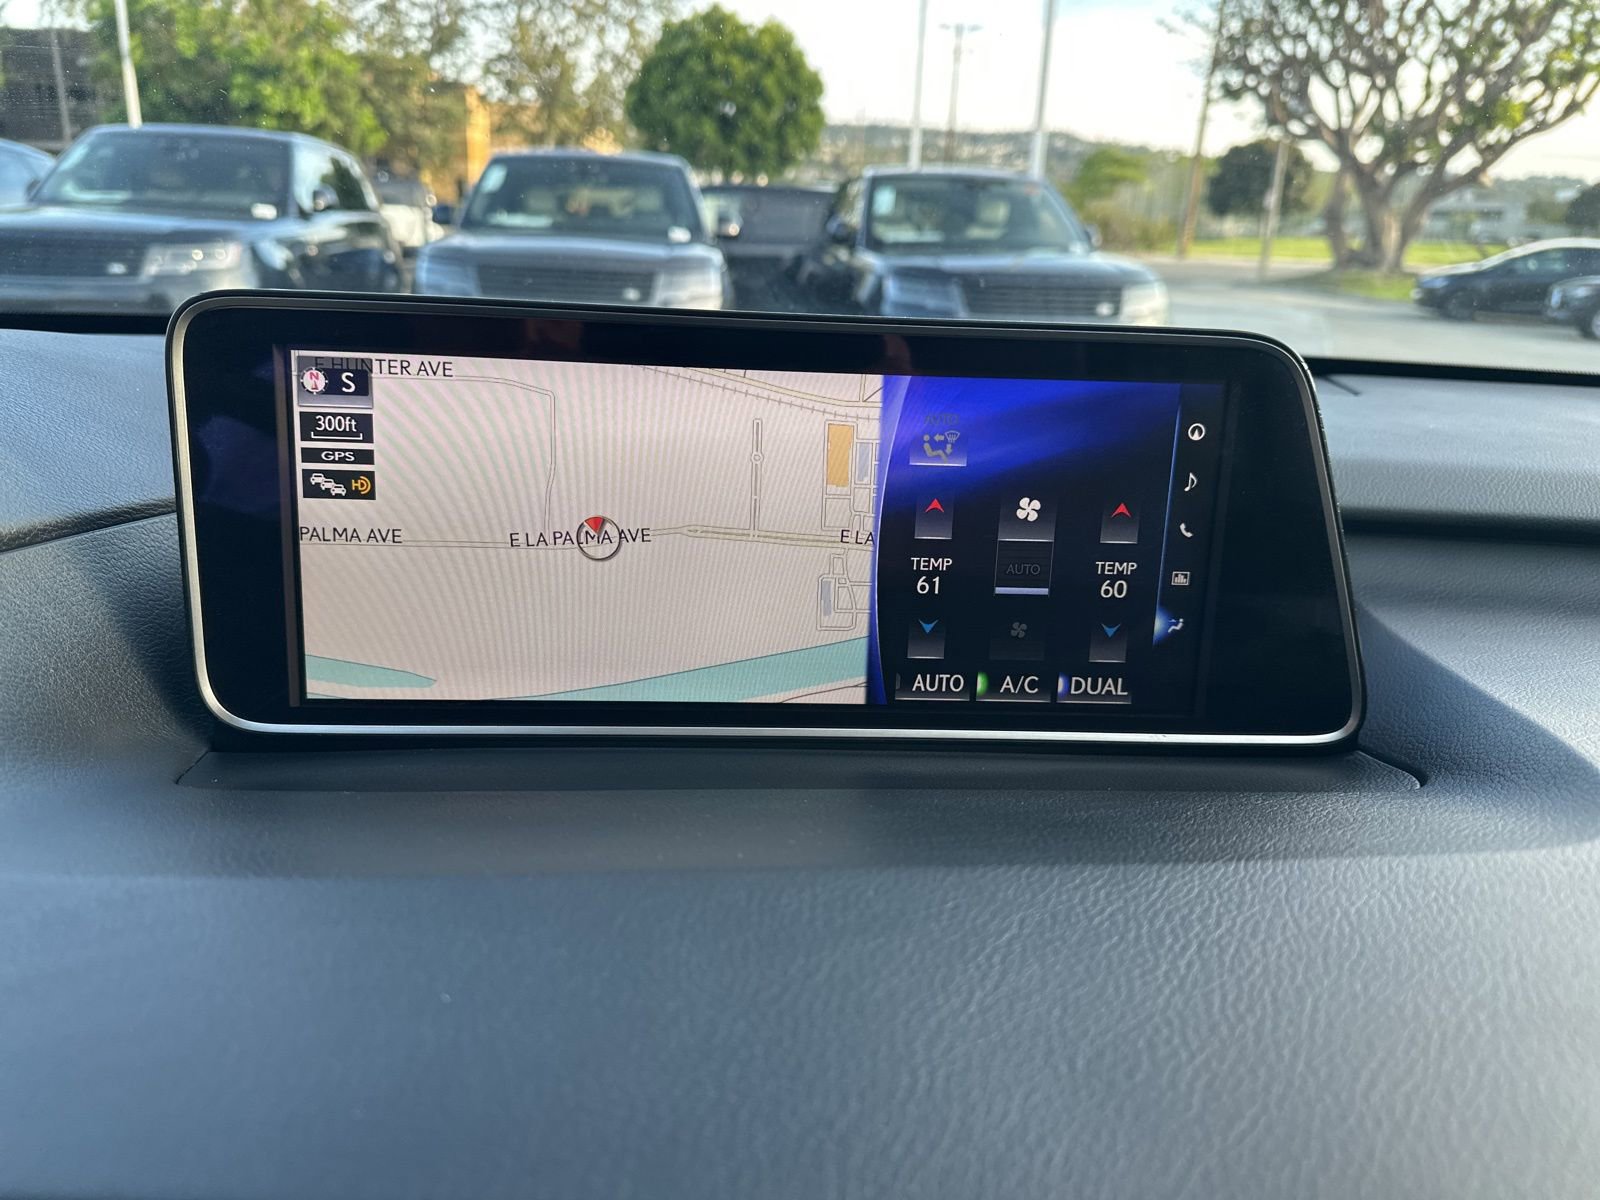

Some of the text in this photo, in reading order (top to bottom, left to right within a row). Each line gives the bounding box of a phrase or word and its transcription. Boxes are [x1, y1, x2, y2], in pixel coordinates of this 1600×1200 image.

[331, 357, 411, 375] HUNTER
[417, 361, 453, 377] AVE
[341, 372, 356, 393] S
[315, 415, 357, 432] 300ft
[923, 414, 960, 426] AUTO
[321, 451, 355, 461] GPS
[300, 526, 402, 544] PALMA AVE
[510, 532, 521, 547] E
[525, 532, 548, 547] LA
[619, 527, 652, 544] AVE
[840, 529, 876, 546] E LA
[911, 557, 952, 571] TEMP
[1006, 563, 1041, 575] AUTO
[1096, 561, 1138, 575] TEMP
[916, 576, 940, 594] 61
[1100, 580, 1128, 599] 60
[912, 674, 964, 692] AUTO
[1000, 675, 1039, 694] A/C
[1070, 676, 1128, 695] DUAL
